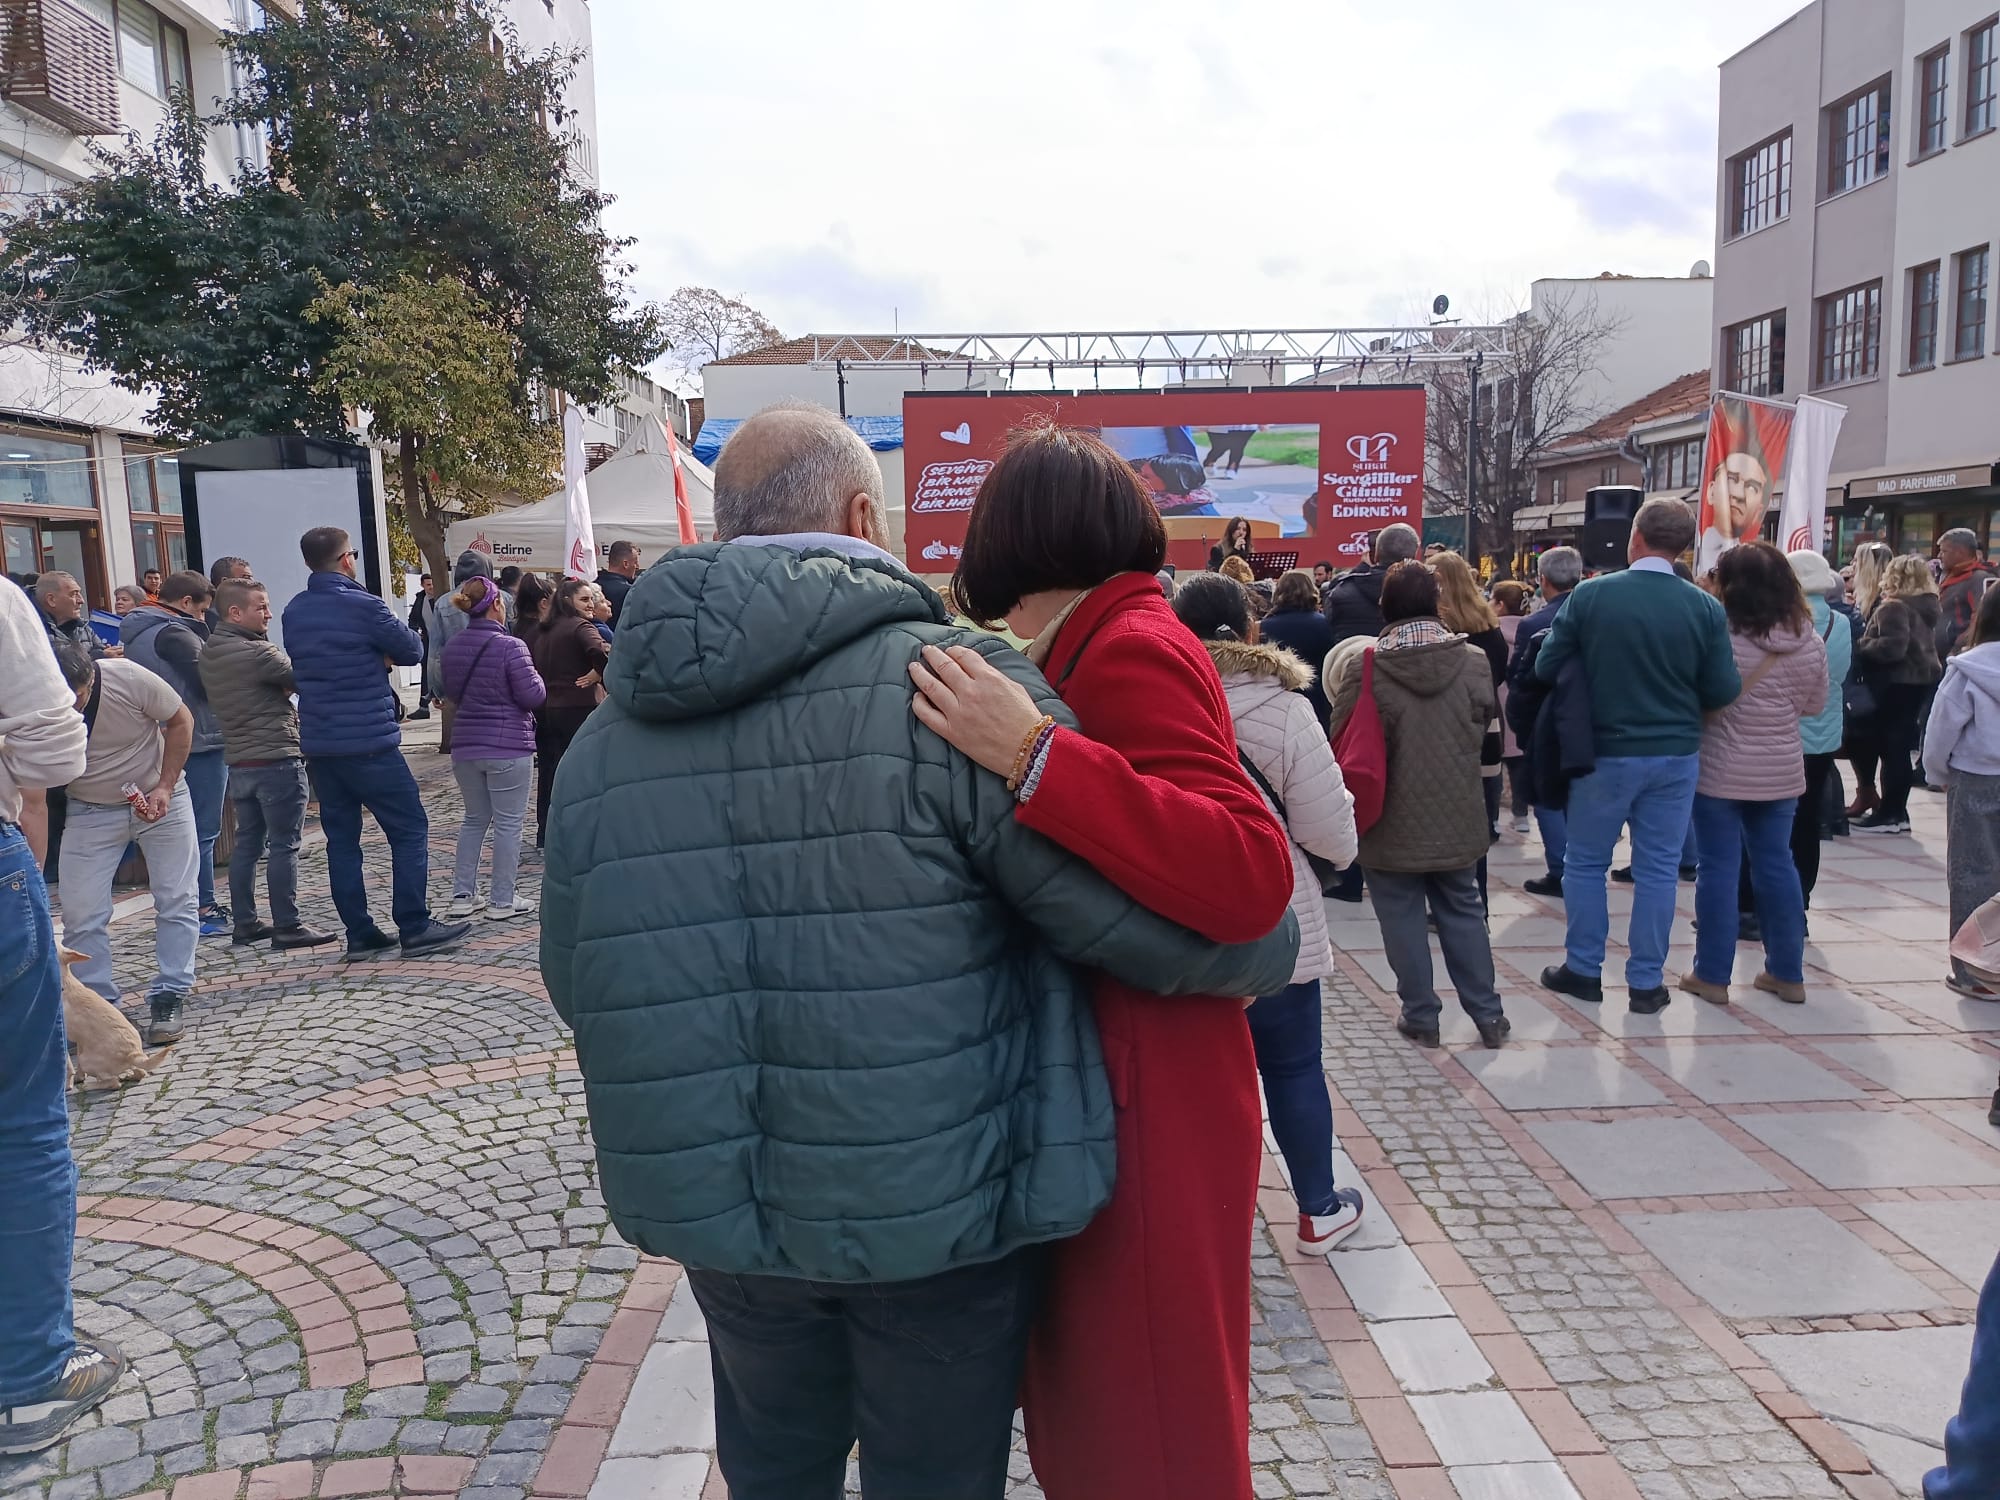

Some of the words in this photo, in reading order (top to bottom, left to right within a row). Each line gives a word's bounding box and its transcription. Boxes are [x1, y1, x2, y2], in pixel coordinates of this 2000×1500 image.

[925, 476, 952, 487] BİR
[1323, 472, 1418, 487] Sevgililer
[1877, 480, 1896, 493] MAD
[1900, 474, 1957, 490] PARFUMEUR
[1335, 486, 1402, 498] Günün
[918, 498, 946, 509] BİR
[1332, 504, 1408, 518] EDİRNE'M
[493, 543, 532, 555] Edirne
